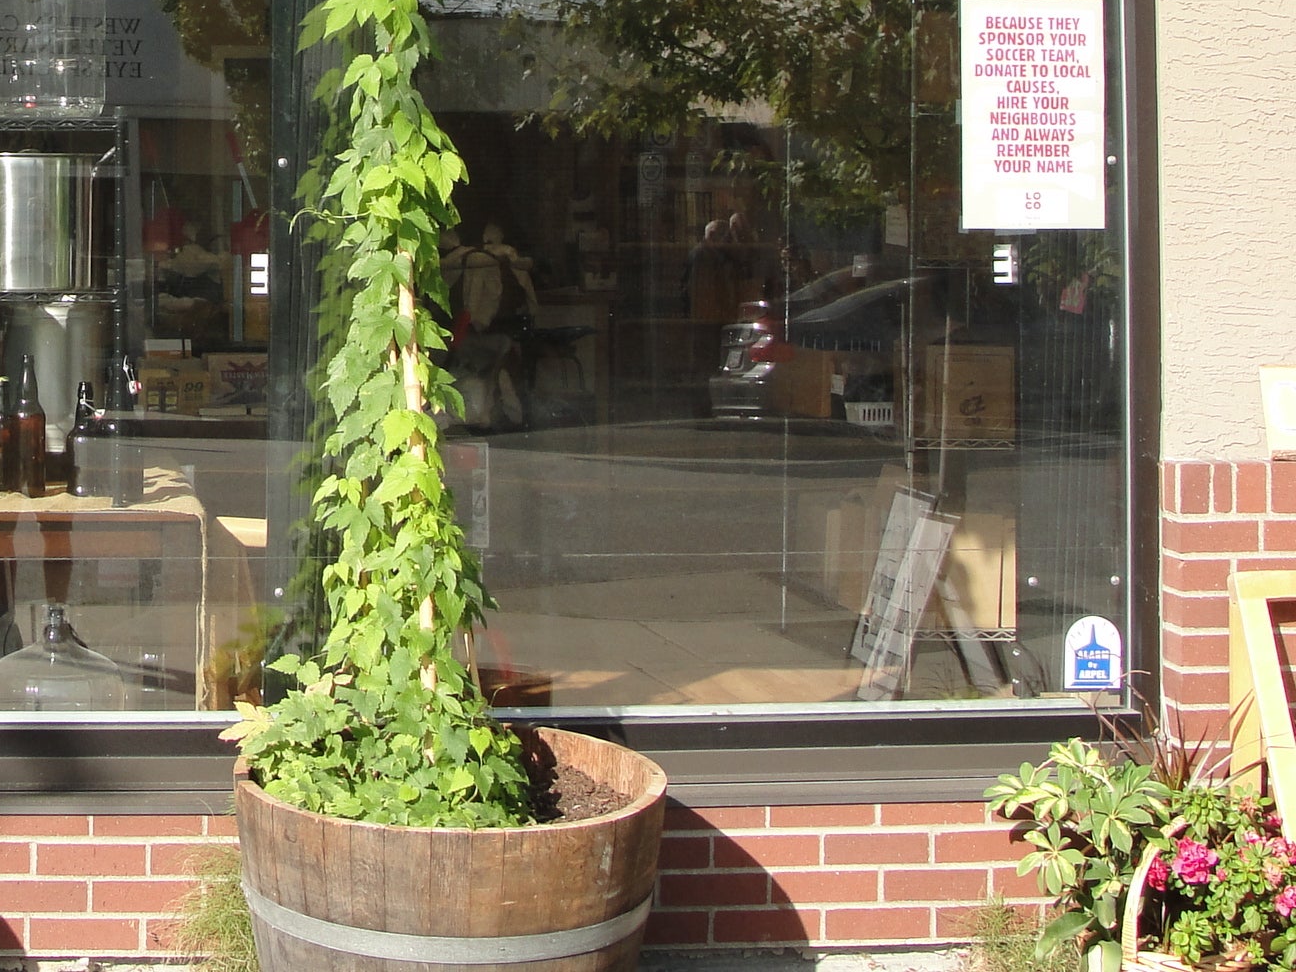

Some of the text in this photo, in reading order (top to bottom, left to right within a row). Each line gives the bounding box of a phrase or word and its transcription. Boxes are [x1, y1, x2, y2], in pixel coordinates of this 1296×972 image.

[985, 16, 1080, 31] BECAUSE THEY
[978, 31, 1086, 47] SPONSOR YOUR
[986, 48, 1080, 64] SOCCER TEAM,
[974, 64, 1091, 78] DONATE TO LOCAL
[1006, 80, 1060, 95] CAUSES,
[997, 96, 1069, 110] HIRE YOUR
[990, 111, 1077, 126] NEIGHBOURS
[991, 128, 1075, 142] AND ALWAYS
[996, 144, 1070, 158] REMEMBER
[994, 159, 1074, 174] YOUR NAME
[1025, 192, 1042, 201] LO
[1025, 201, 1042, 210] CO
